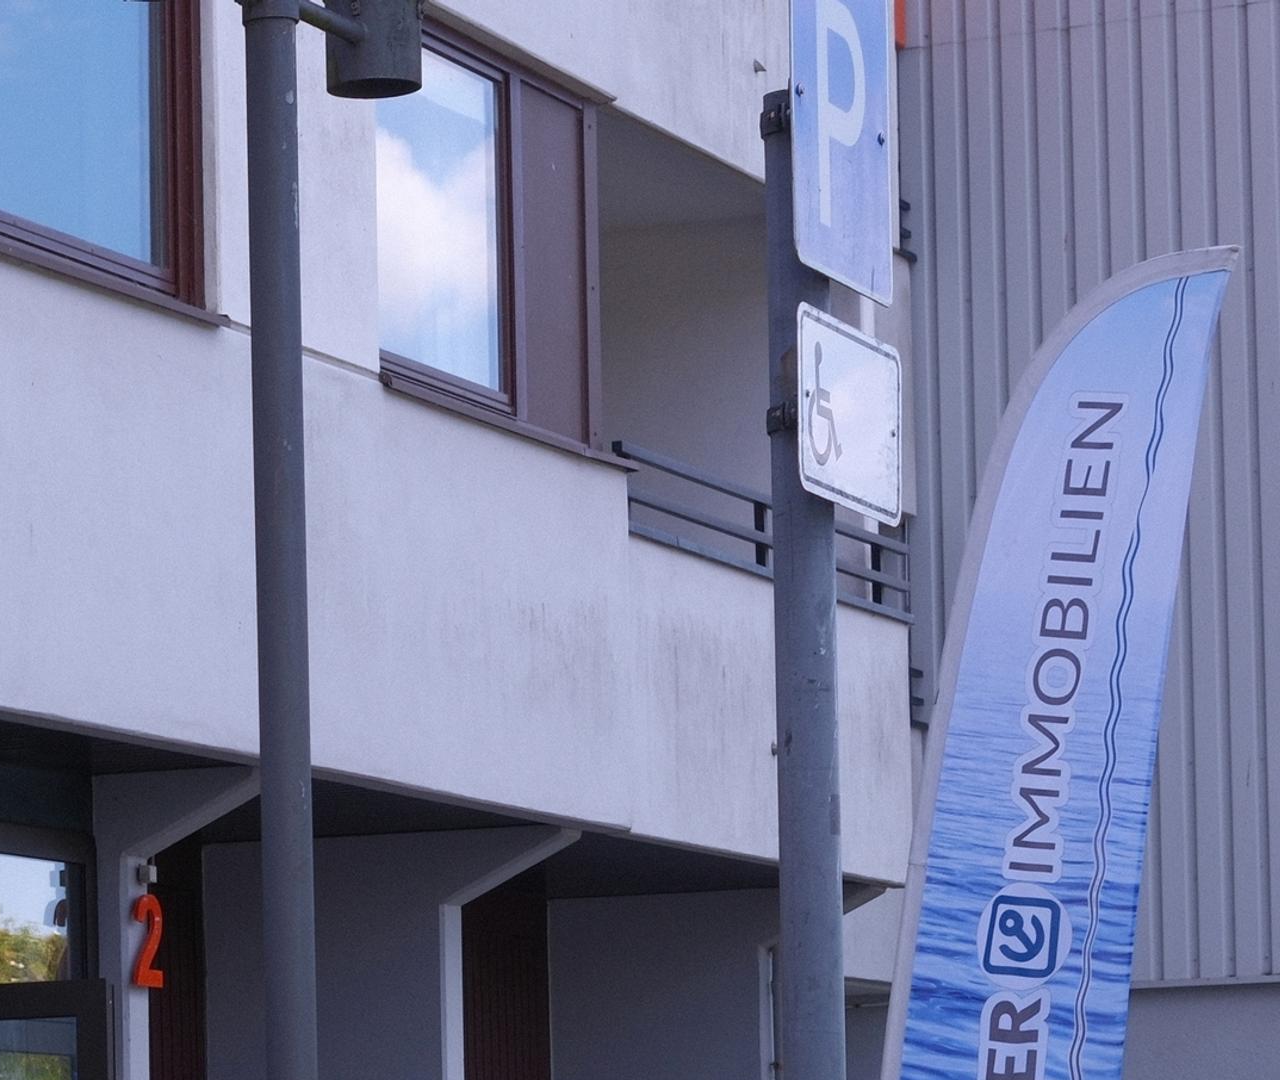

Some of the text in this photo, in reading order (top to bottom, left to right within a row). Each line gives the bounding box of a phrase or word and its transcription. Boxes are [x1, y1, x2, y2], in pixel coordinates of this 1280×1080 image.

[816, 0, 866, 228] P
[1007, 400, 1125, 876] IMMOBILIEN
[133, 893, 165, 988] 2
